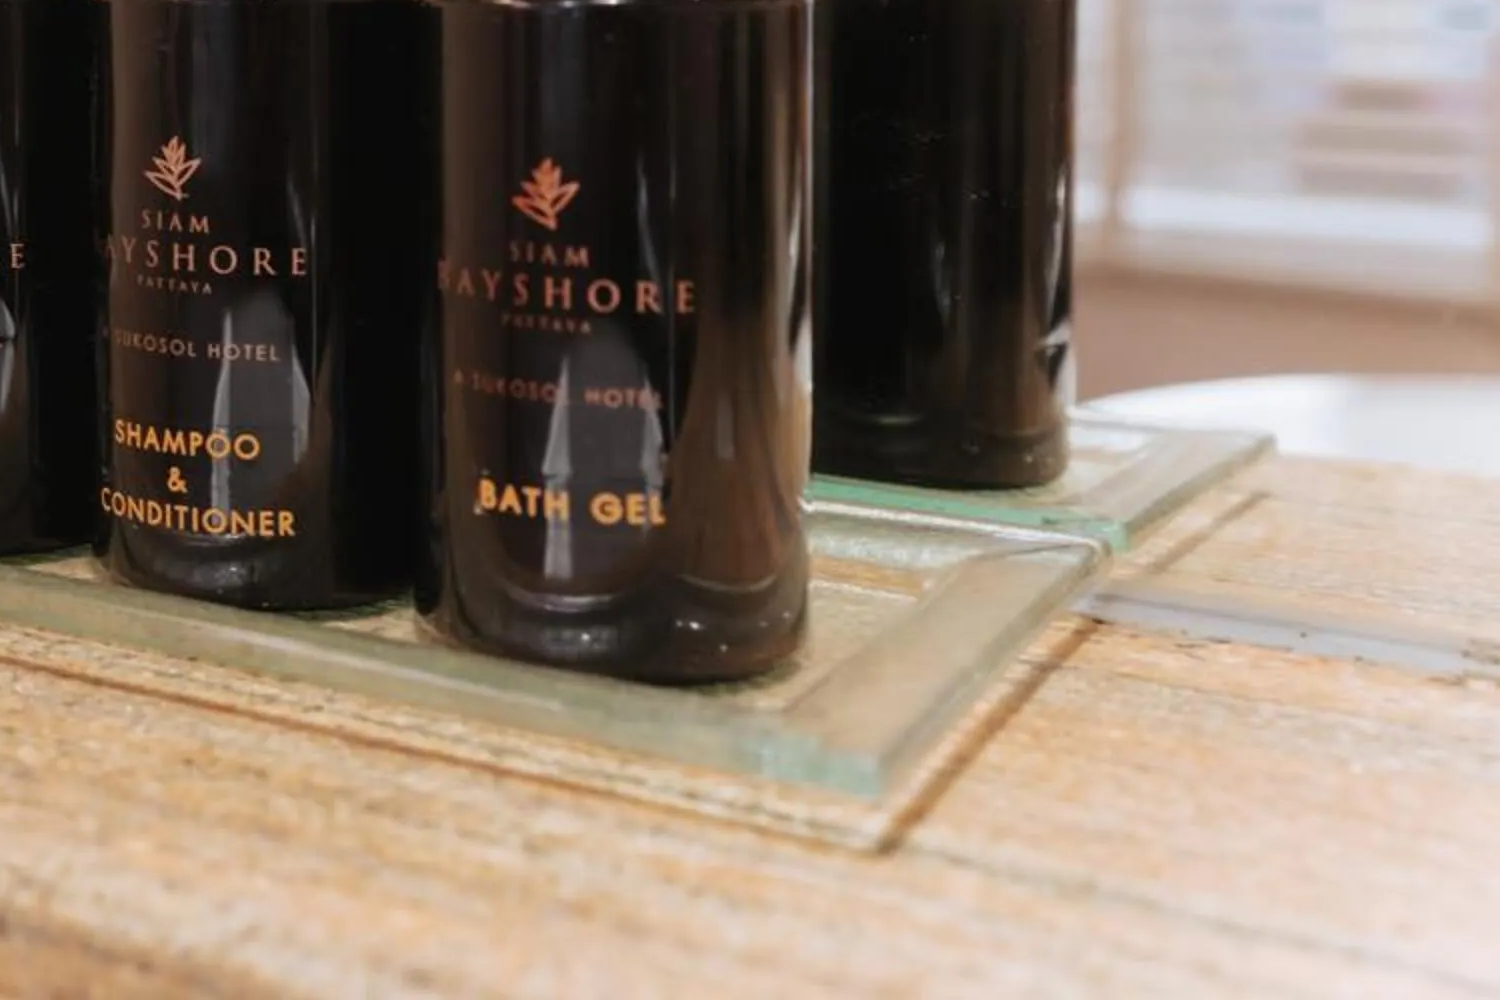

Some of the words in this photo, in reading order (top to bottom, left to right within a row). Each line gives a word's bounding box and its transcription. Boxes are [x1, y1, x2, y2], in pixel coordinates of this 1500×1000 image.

[141, 210, 210, 234] SIAM
[104, 235, 307, 276] AYSHORE
[510, 241, 590, 269] SIAM
[137, 273, 212, 296] PATTAYA
[115, 328, 198, 359] SUKOSOL
[206, 342, 280, 362] HOTEL
[471, 371, 566, 404] SUKOSO
[114, 417, 260, 462] SHAMPOO
[165, 464, 189, 494] &
[100, 486, 296, 538] CONDITIONER
[478, 476, 569, 521] BATH
[589, 491, 668, 526] GEL
